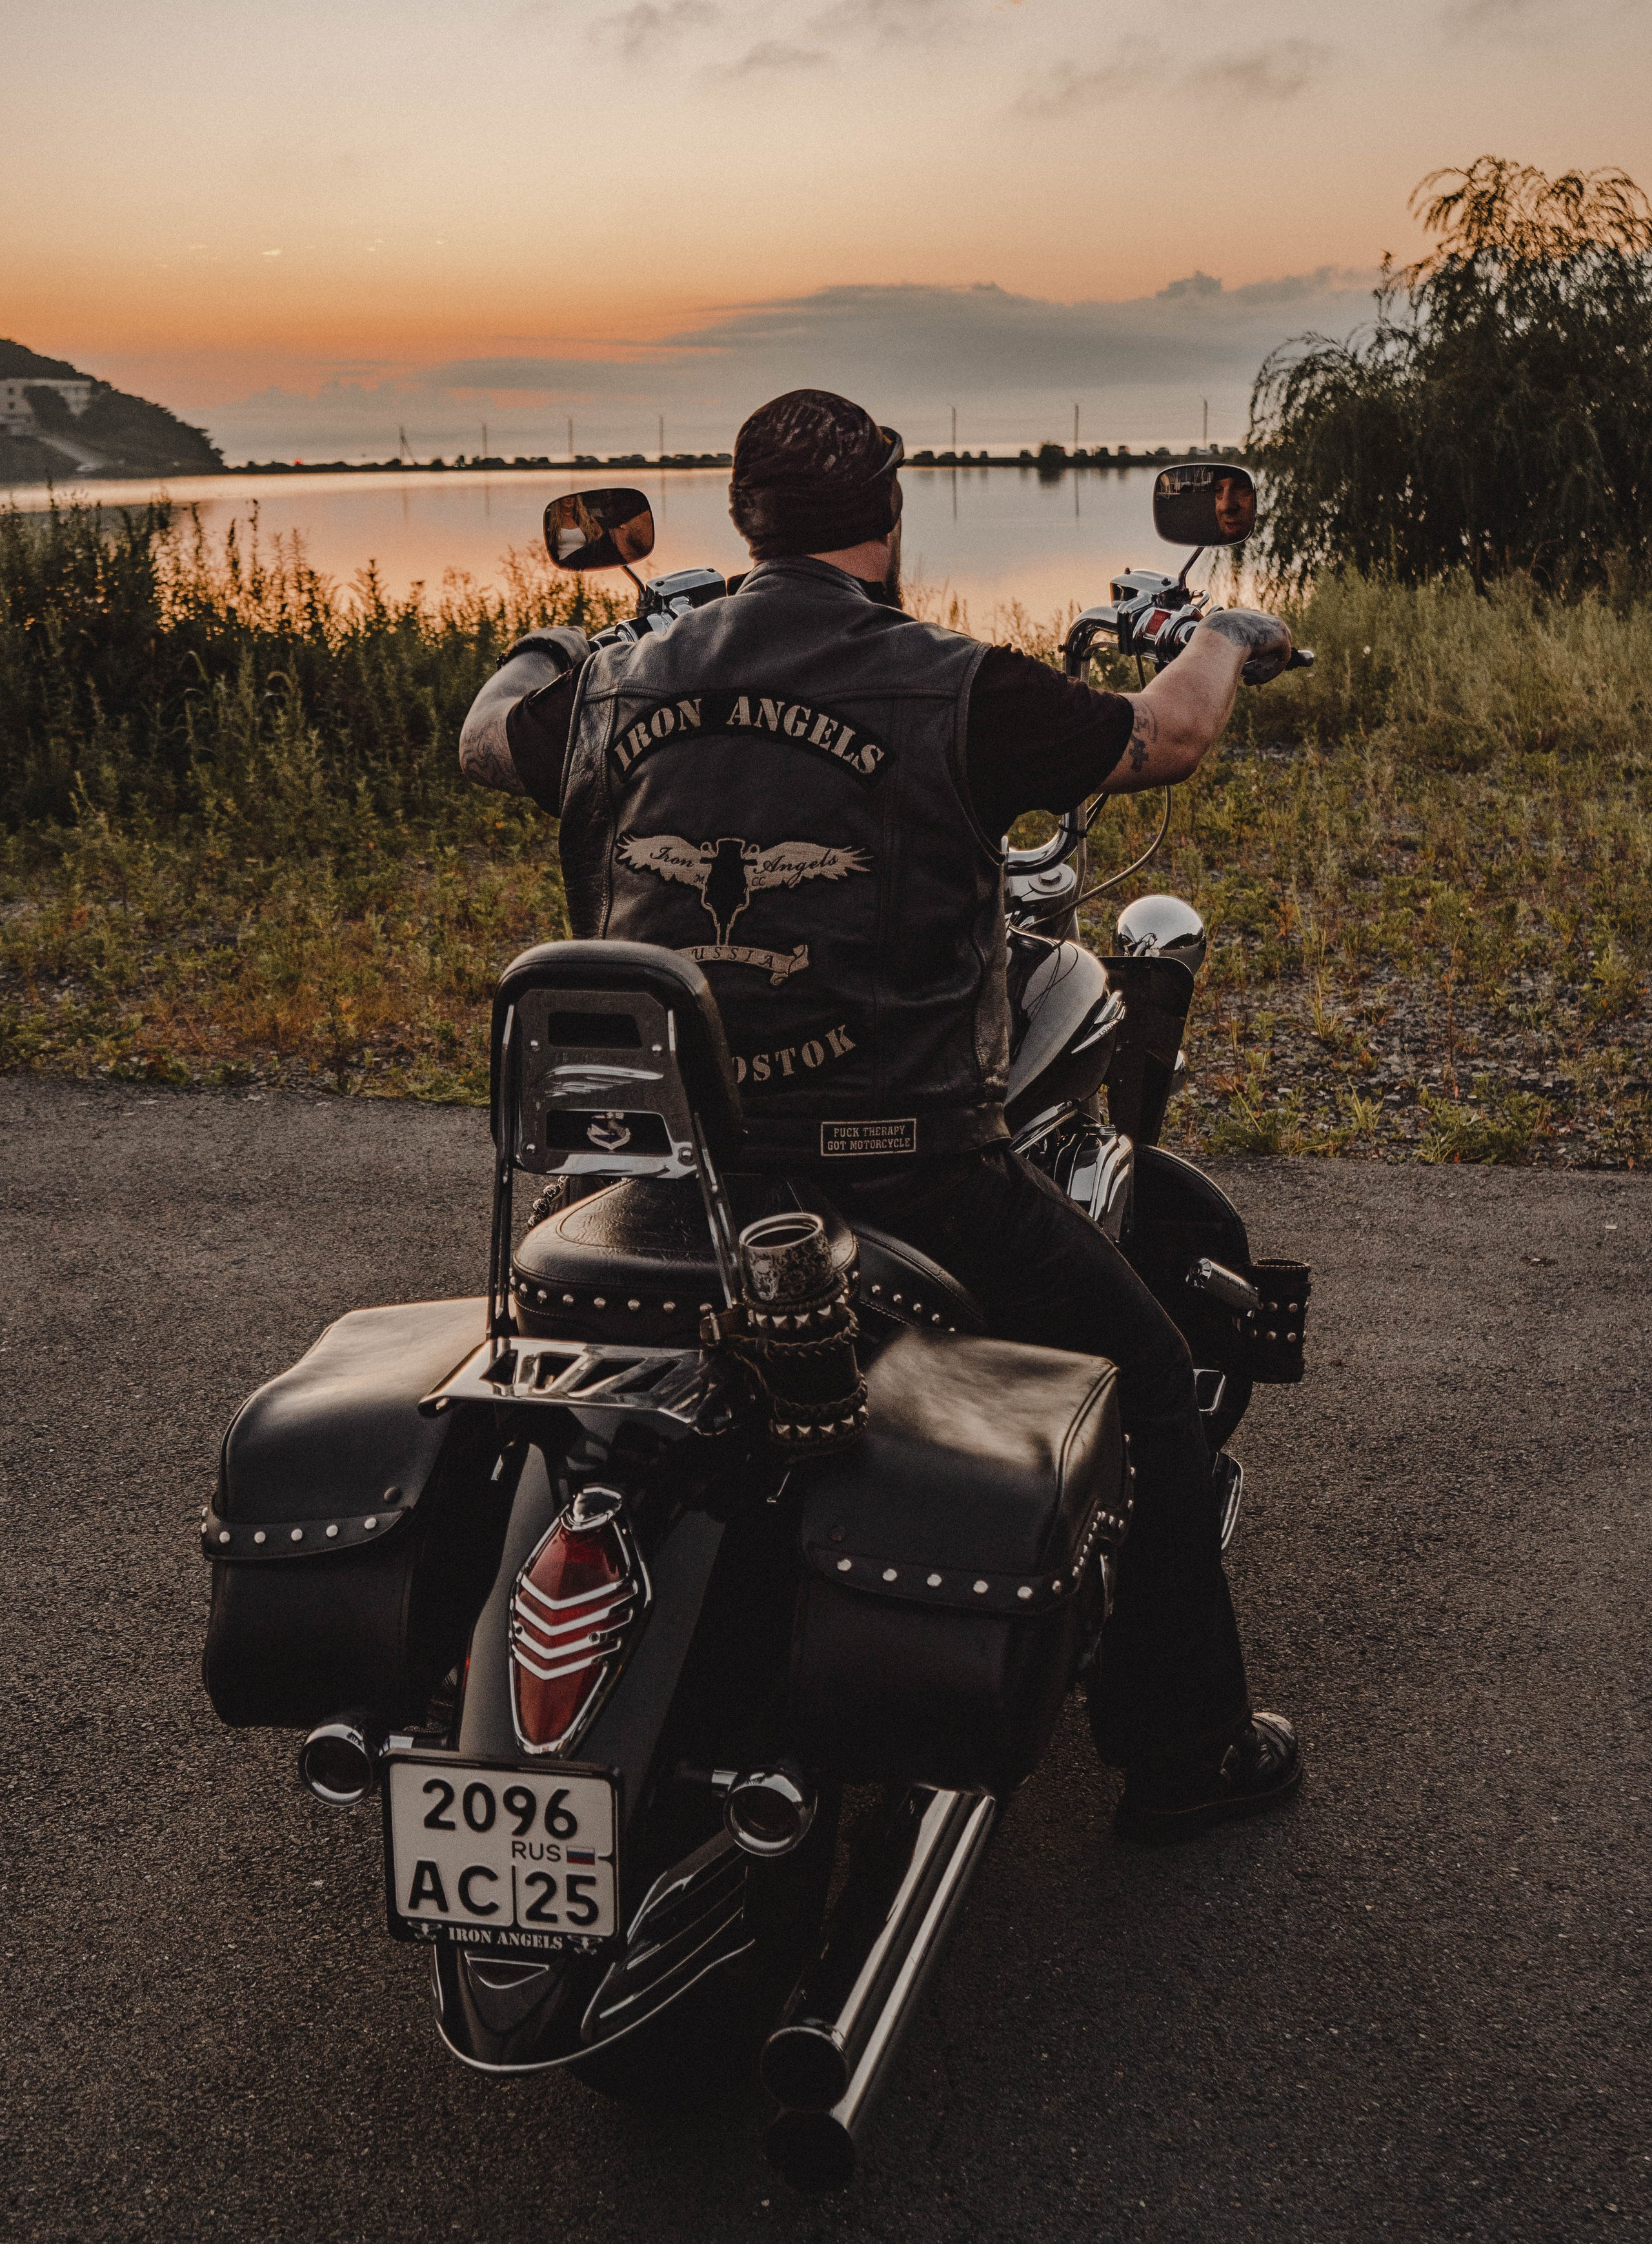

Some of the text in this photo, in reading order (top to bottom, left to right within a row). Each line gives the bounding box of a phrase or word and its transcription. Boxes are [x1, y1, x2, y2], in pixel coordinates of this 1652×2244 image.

[614, 695, 884, 776] IRON ANGELS
[650, 847, 839, 886] Iron Angels
[827, 1137, 911, 1151] GOT MOTORCYCLE
[862, 1125, 905, 1137] THERAPY
[422, 1778, 578, 1839] 2096
[511, 1841, 561, 1862] RUS
[408, 1860, 599, 1926] AC 25
[448, 1927, 563, 1950] IRON ANGELS
